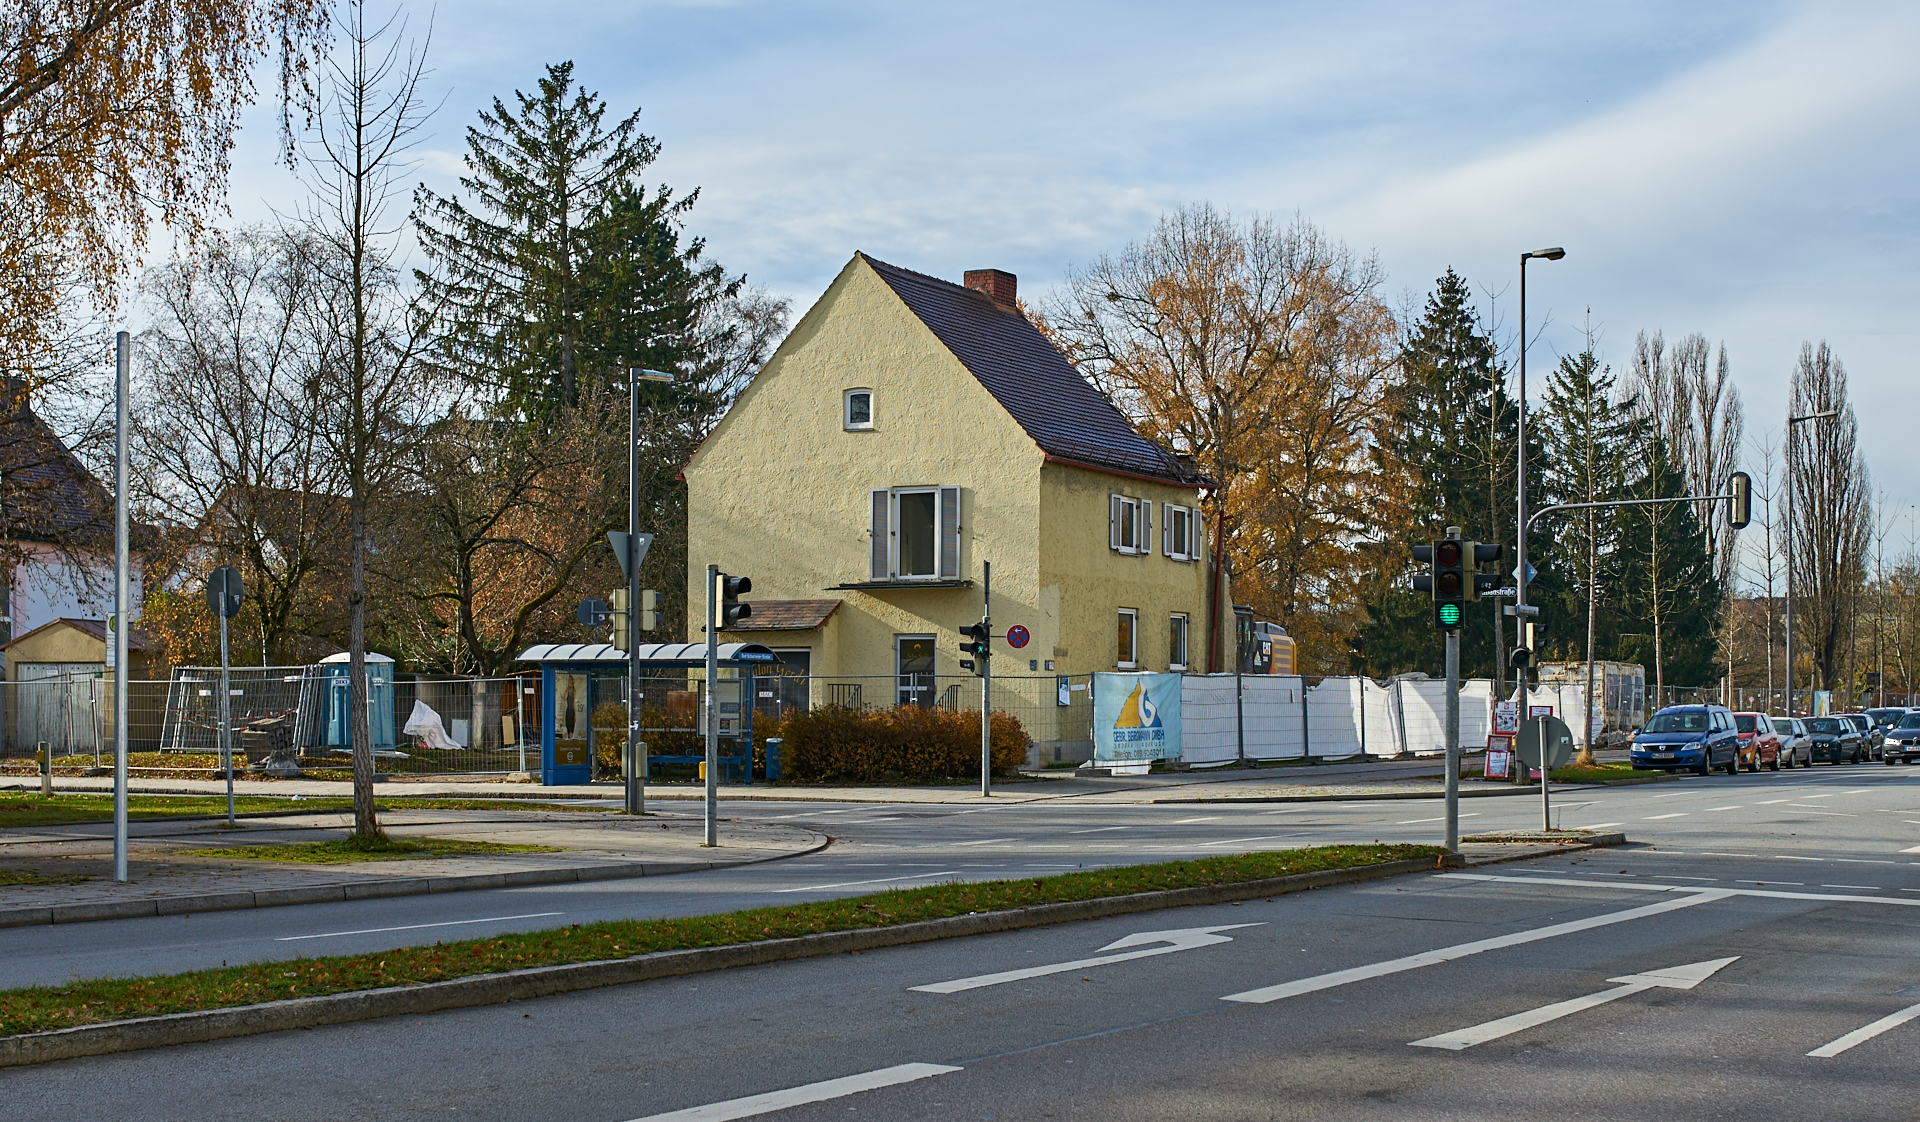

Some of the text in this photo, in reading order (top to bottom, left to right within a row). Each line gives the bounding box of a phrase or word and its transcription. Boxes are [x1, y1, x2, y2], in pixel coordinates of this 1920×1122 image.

[1263, 642, 1271, 655] CAT
[1113, 731, 1127, 742] GEBR.
[1127, 730, 1150, 742] BERGMANN
